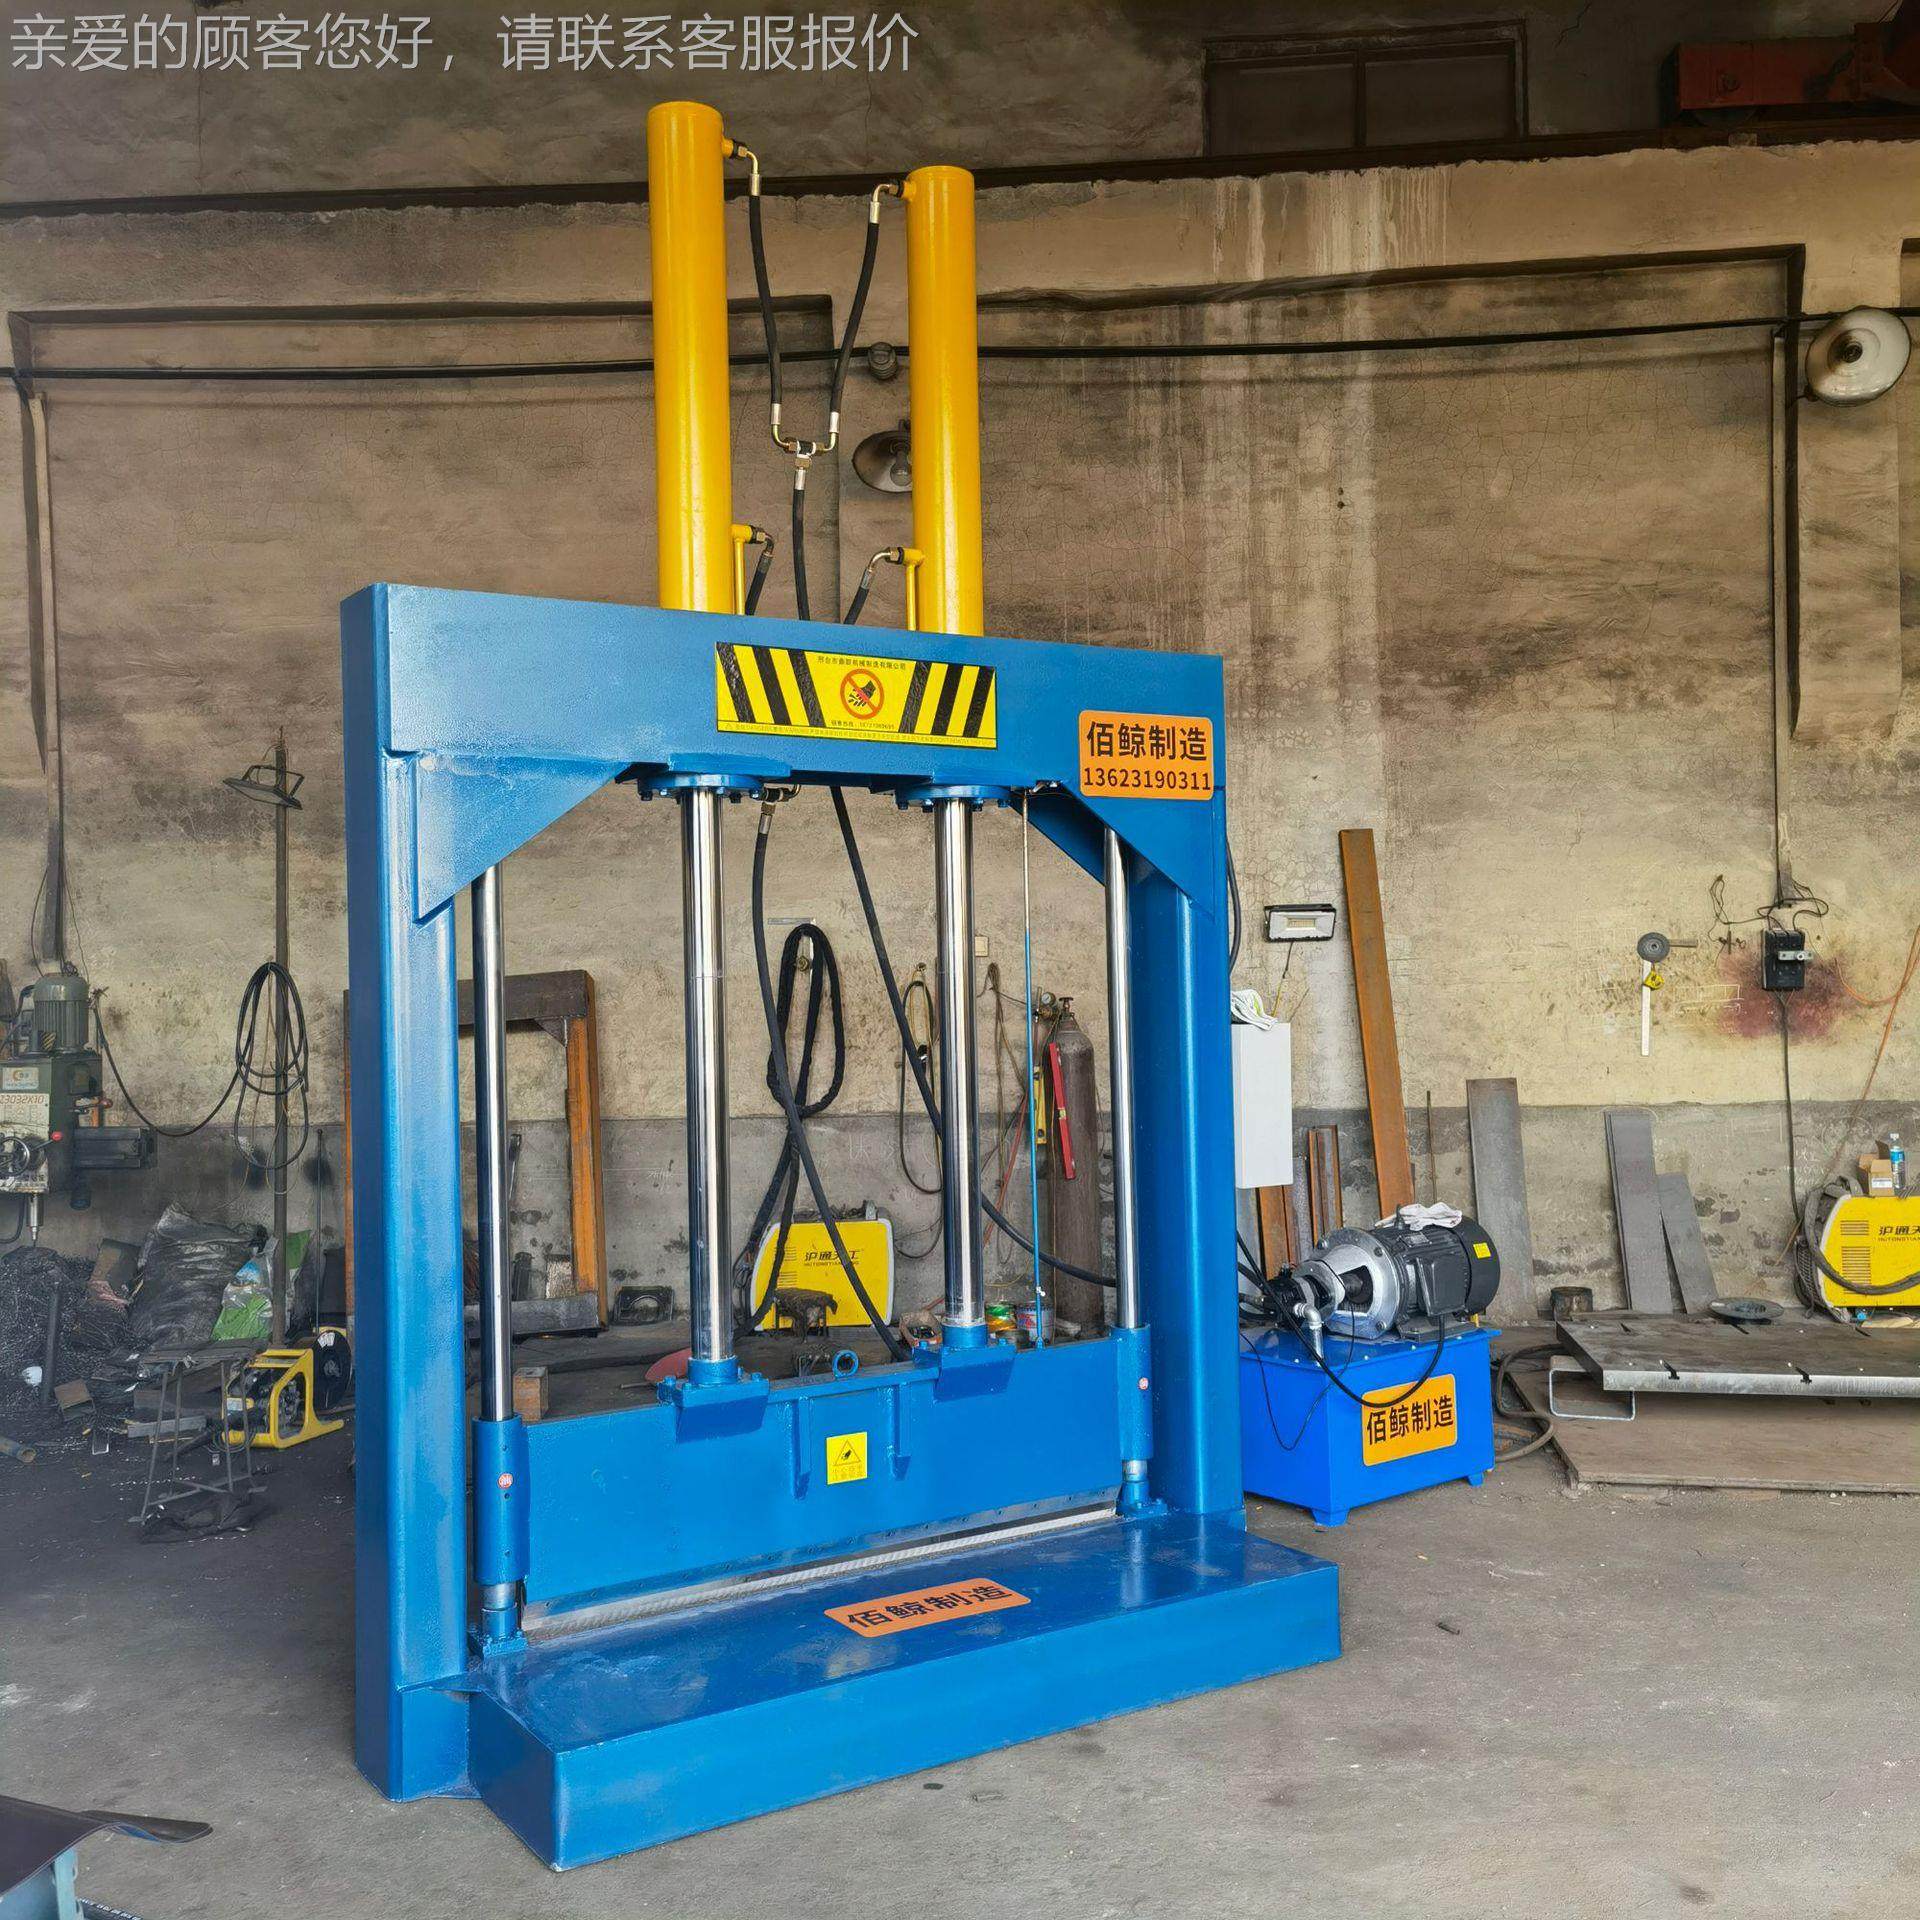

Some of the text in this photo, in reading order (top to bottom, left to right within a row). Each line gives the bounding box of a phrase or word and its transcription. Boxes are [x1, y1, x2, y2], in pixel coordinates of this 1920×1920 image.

[1087, 721, 1207, 761] 佰鲸制造
[1084, 767, 1211, 790] 13623190311
[1367, 1395, 1453, 1445] 佰鲸制造
[848, 1585, 1012, 1628] 佰鲸制造
